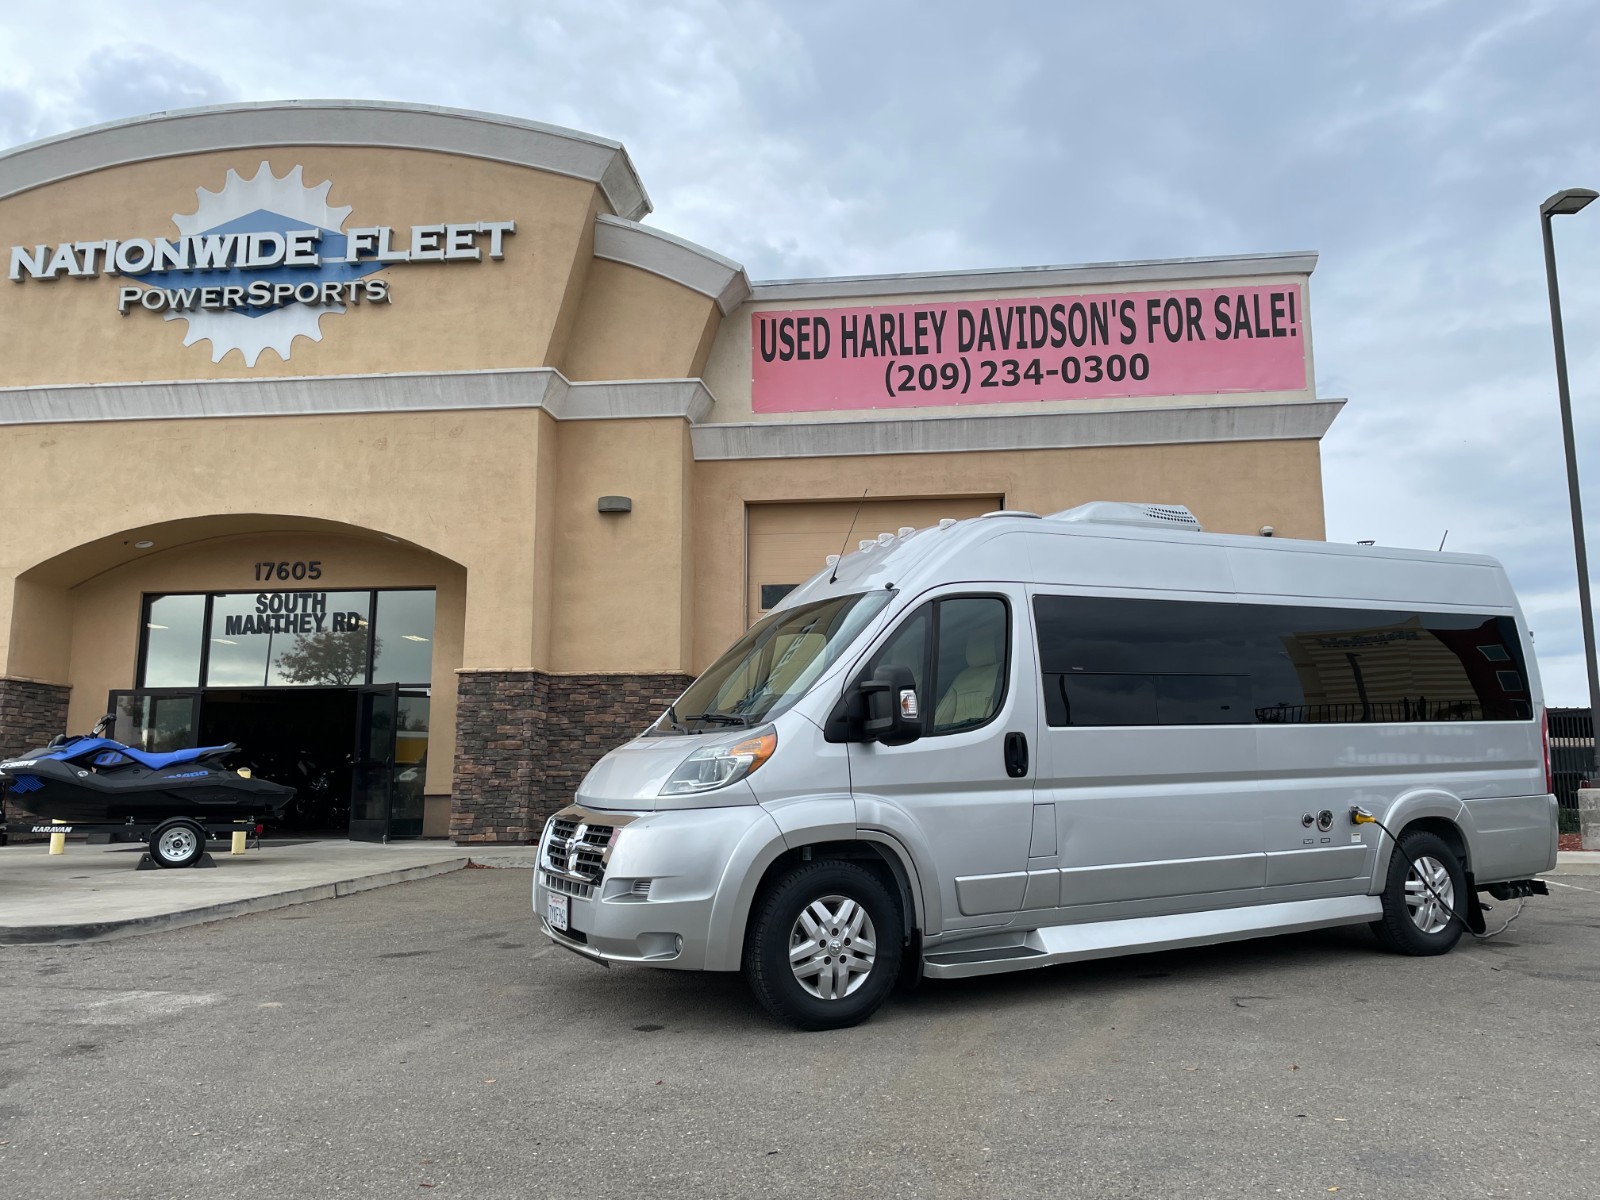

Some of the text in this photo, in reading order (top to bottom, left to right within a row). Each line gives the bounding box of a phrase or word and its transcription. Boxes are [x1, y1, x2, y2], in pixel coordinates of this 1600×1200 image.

[9, 220, 516, 282] NATIONWIDE FLEET
[760, 292, 1297, 362] USED HARLEY DAVIDSON'S FOR SALE!
[884, 353, 1149, 397] (209) 234-0300
[255, 561, 322, 581] 17605
[255, 593, 327, 614] SOUTH
[225, 612, 361, 635] MANTHEY RD
